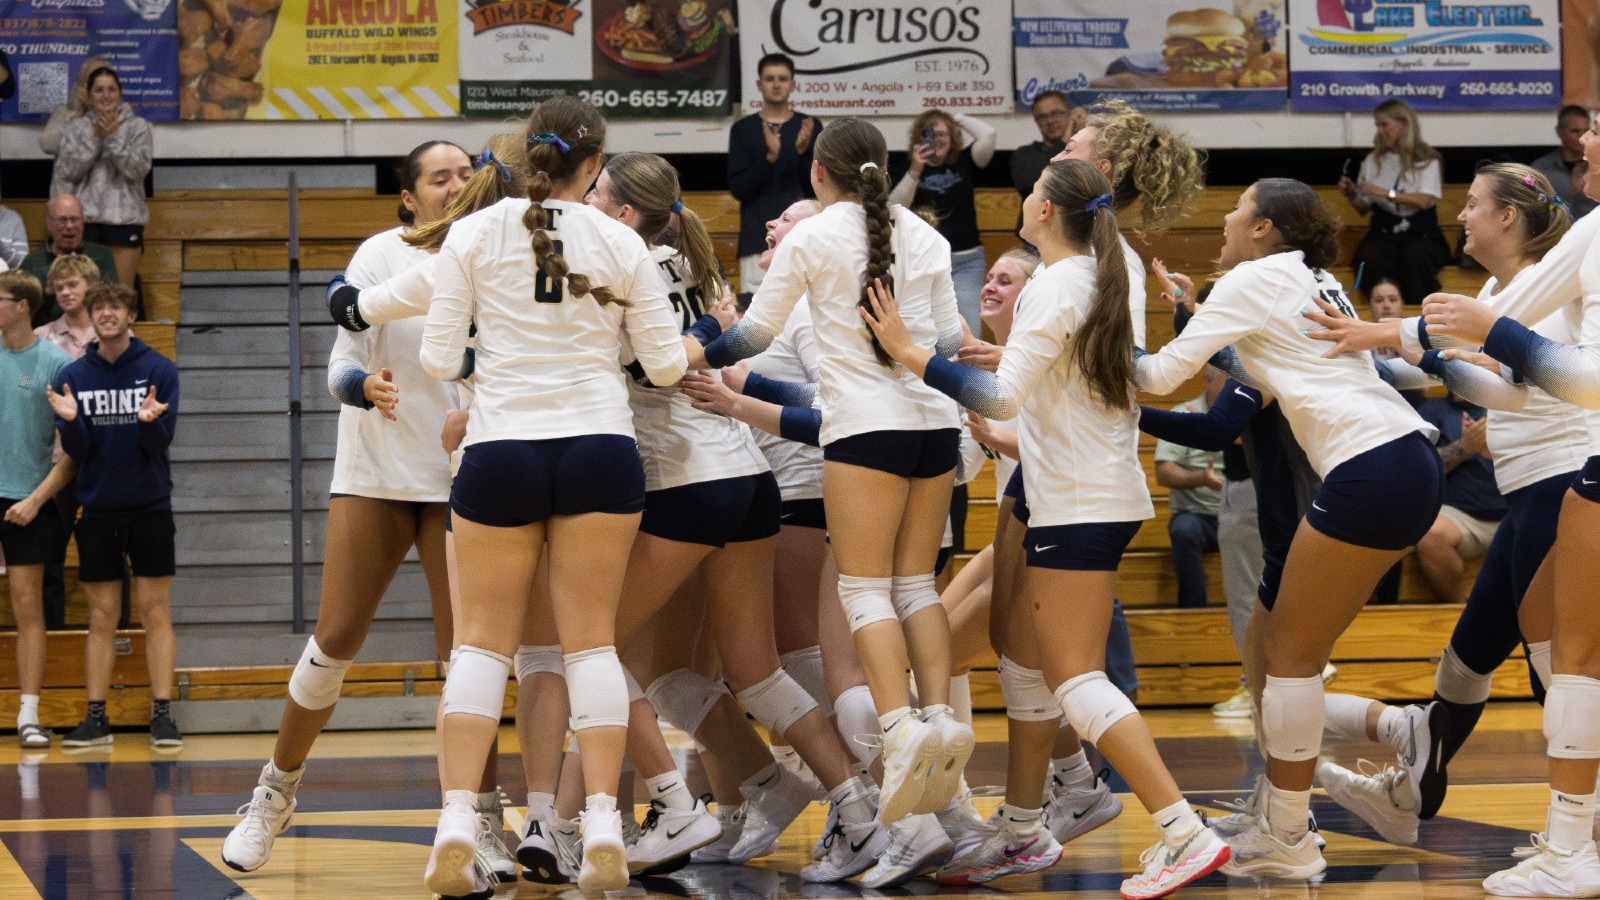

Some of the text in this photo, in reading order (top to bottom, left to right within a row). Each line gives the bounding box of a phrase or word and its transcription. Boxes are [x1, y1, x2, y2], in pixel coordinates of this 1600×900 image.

[306, 0, 438, 26] ANGOLA
[480, 3, 566, 25] TIMBERS
[306, 26, 437, 39] BUFFALO WILD WINGS
[770, 0, 980, 56] Caruso's
[1020, 21, 1038, 33] NOW
[1039, 21, 1083, 33] DELIVERING
[20, 43, 91, 55] THUNDER!
[518, 42, 529, 52] &
[1308, 43, 1548, 55] COMMERCIAL INDUSTRIAL SERVICE
[504, 52, 545, 63] Seafood
[948, 60, 978, 72] 1976
[466, 87, 487, 97] 1212
[490, 87, 518, 97] West
[805, 82, 830, 93] 200
[834, 82, 847, 92] W
[861, 82, 904, 94] Angola
[916, 81, 941, 92] I-69
[945, 81, 967, 91] Exit
[972, 81, 995, 91] 350
[1300, 82, 1554, 98] 210 Growth Parkway 260-665-8020
[578, 89, 728, 108] 260-665-7487
[749, 97, 1004, 109] cas-restaurant.com 260.833.2617
[466, 100, 541, 112] timbersangol
[658, 258, 682, 284] T
[77, 387, 147, 416] TRINE
